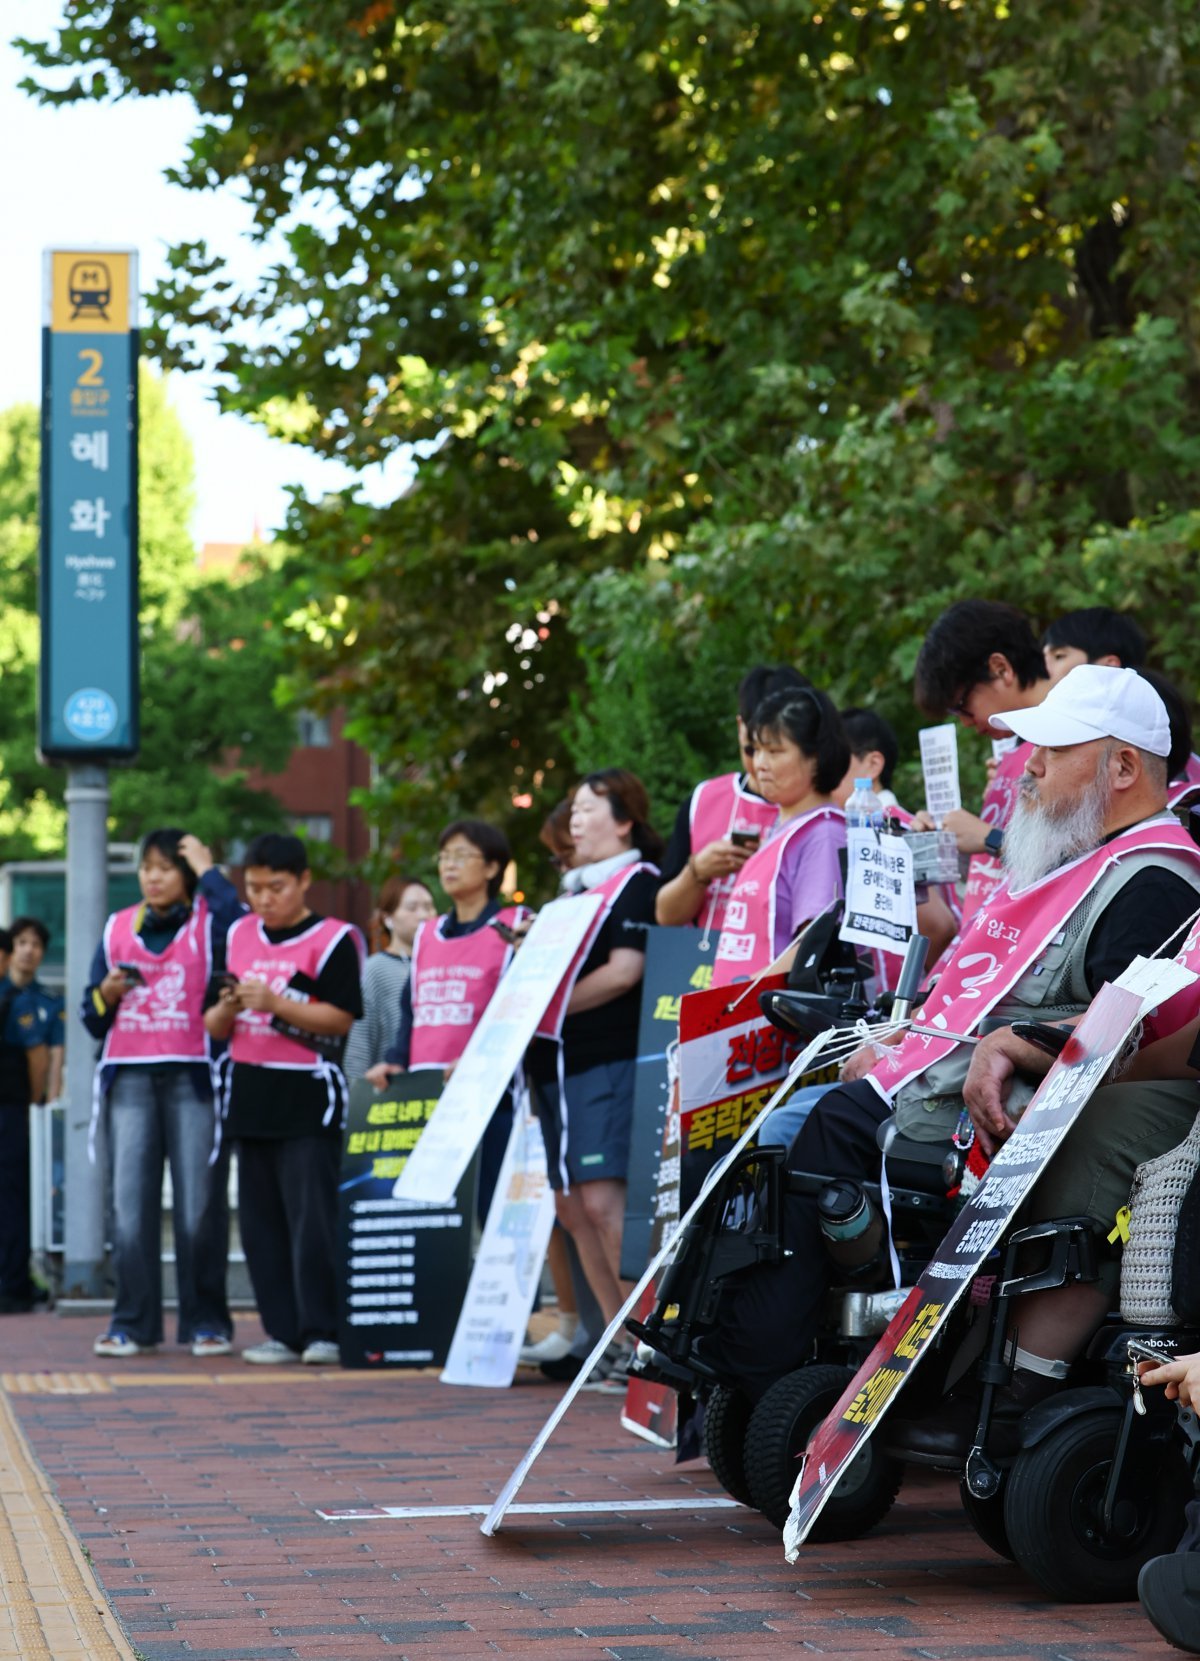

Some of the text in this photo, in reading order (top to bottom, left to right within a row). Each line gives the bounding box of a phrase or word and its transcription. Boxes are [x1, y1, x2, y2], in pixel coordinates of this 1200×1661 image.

[78, 349, 103, 386] 2
[69, 430, 109, 472] 혜
[69, 496, 112, 539] 화
[65, 555, 116, 570] Hyehwa
[987, 918, 1021, 944] 않고
[1034, 1064, 1085, 1111] 오세훈
[894, 1303, 944, 1359] 해고는
[843, 1367, 906, 1425] 살인이다
